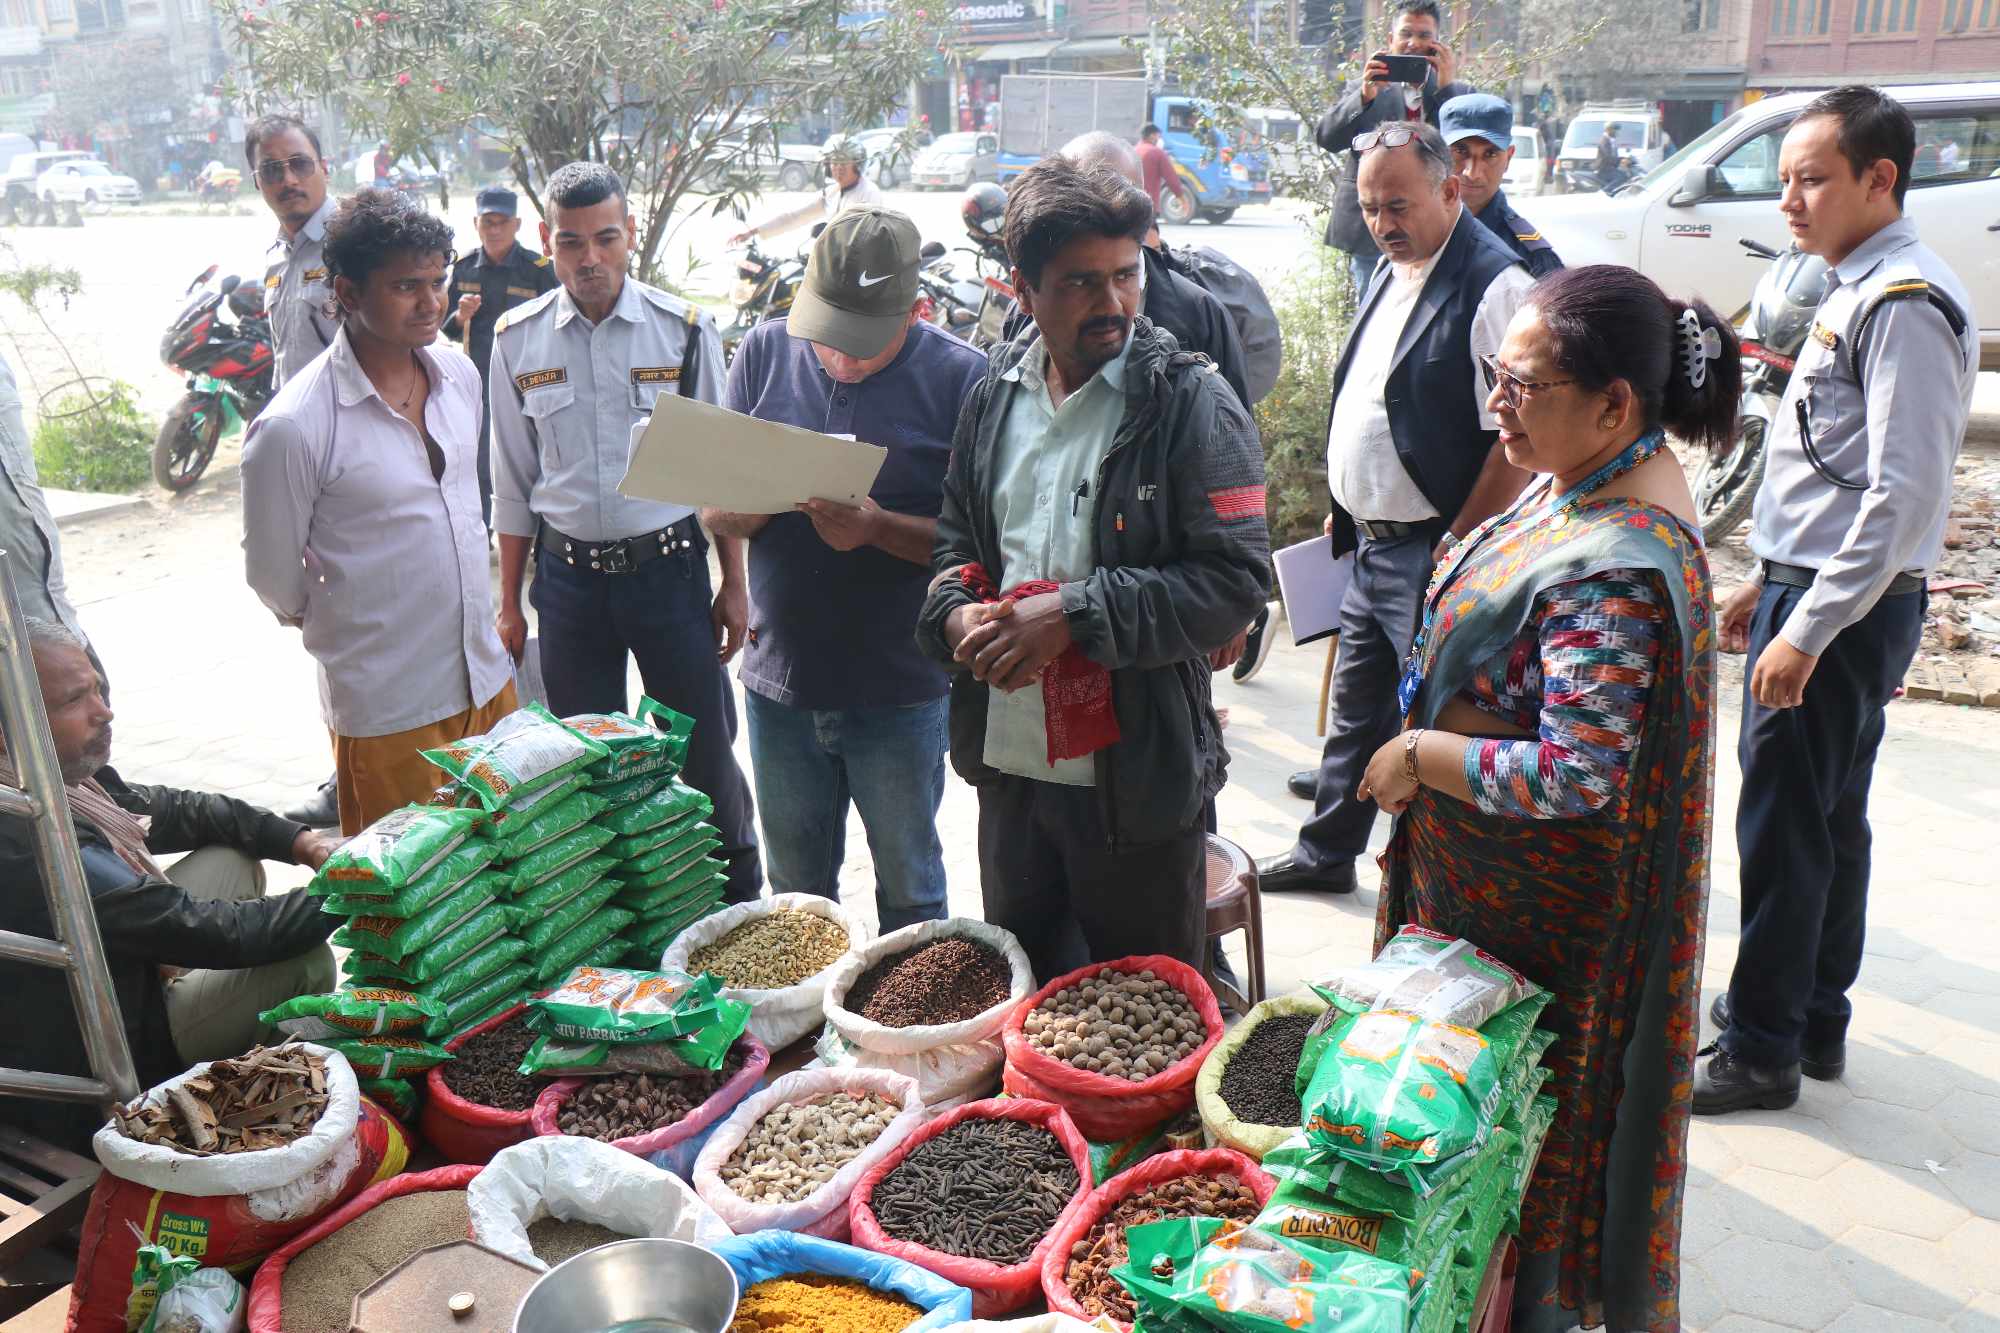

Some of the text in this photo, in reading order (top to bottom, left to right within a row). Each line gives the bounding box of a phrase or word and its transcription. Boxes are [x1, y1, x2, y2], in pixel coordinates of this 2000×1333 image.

[1664, 224, 1712, 233] YODHA
[161, 1213, 208, 1234] Gross Wt.
[160, 1234, 205, 1255] 20 Kg.
